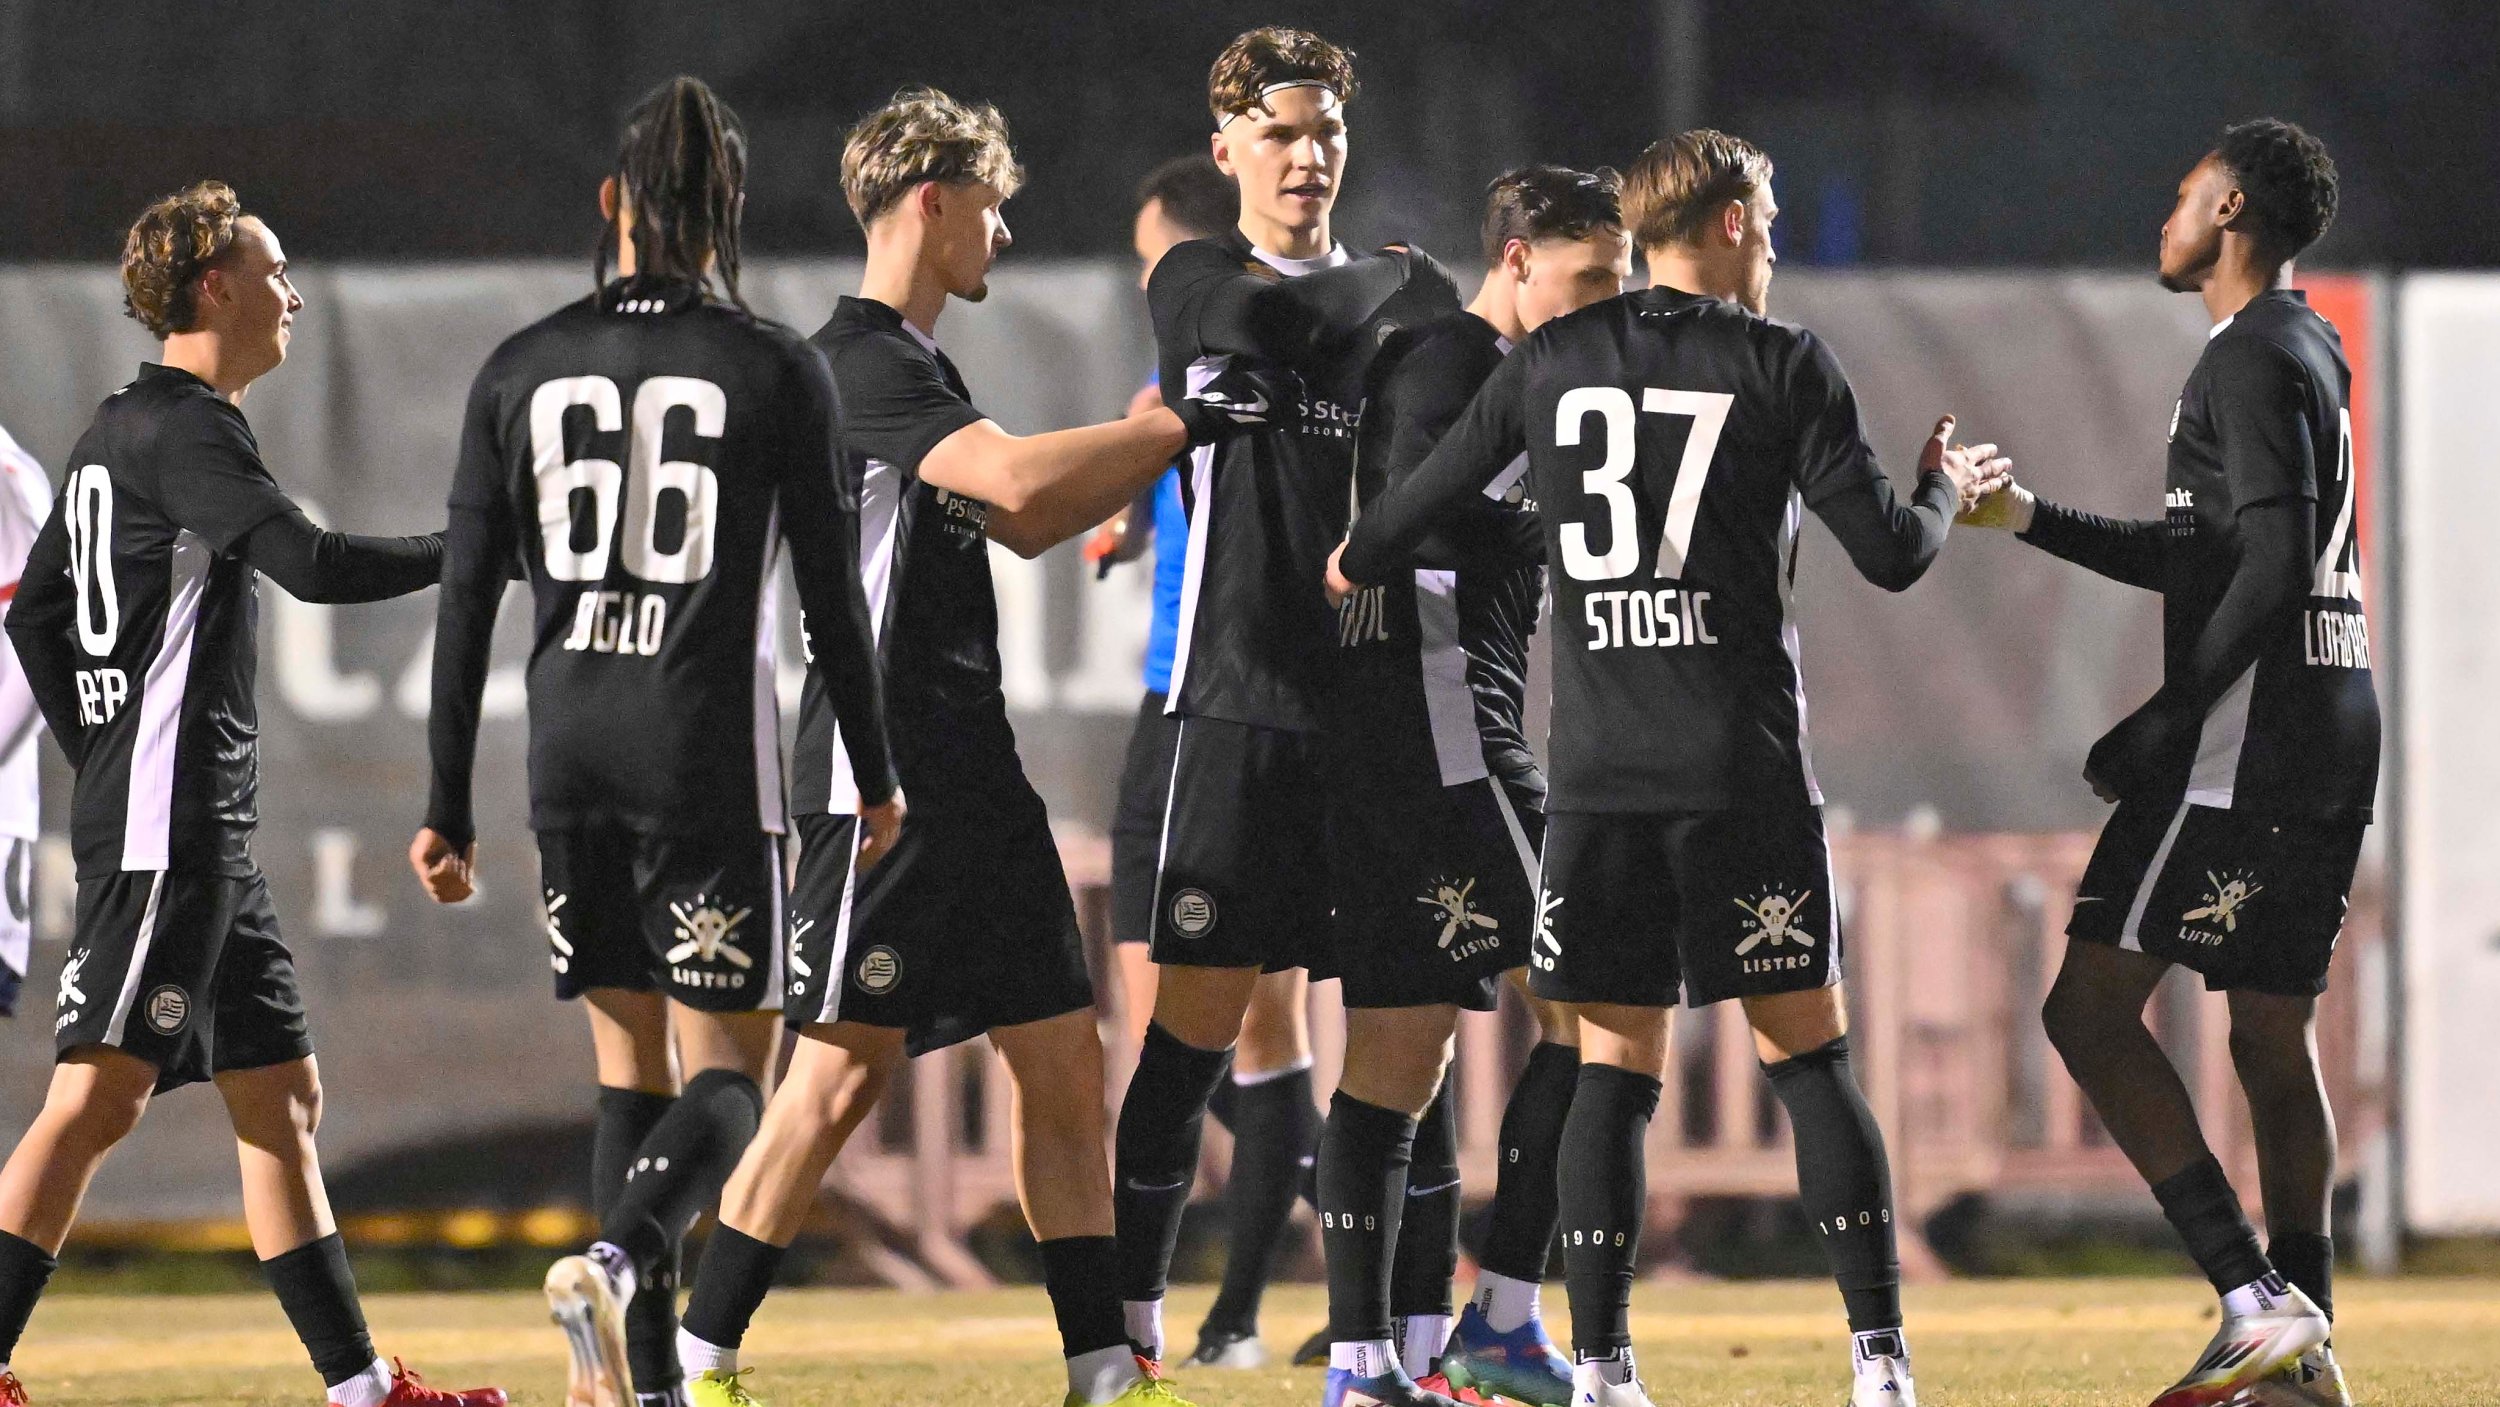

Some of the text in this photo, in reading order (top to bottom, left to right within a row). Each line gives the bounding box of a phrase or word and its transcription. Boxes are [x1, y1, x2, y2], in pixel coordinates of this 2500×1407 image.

[530, 375, 727, 584] 66
[1556, 387, 1735, 581] 37
[2311, 407, 2363, 603] 2
[1585, 589, 1718, 650] STOSIC
[672, 966, 745, 989] LISTRO
[1743, 953, 1811, 974] LISTRO
[1562, 1229, 1625, 1248] 1909
[1820, 1208, 1889, 1235] 1909
